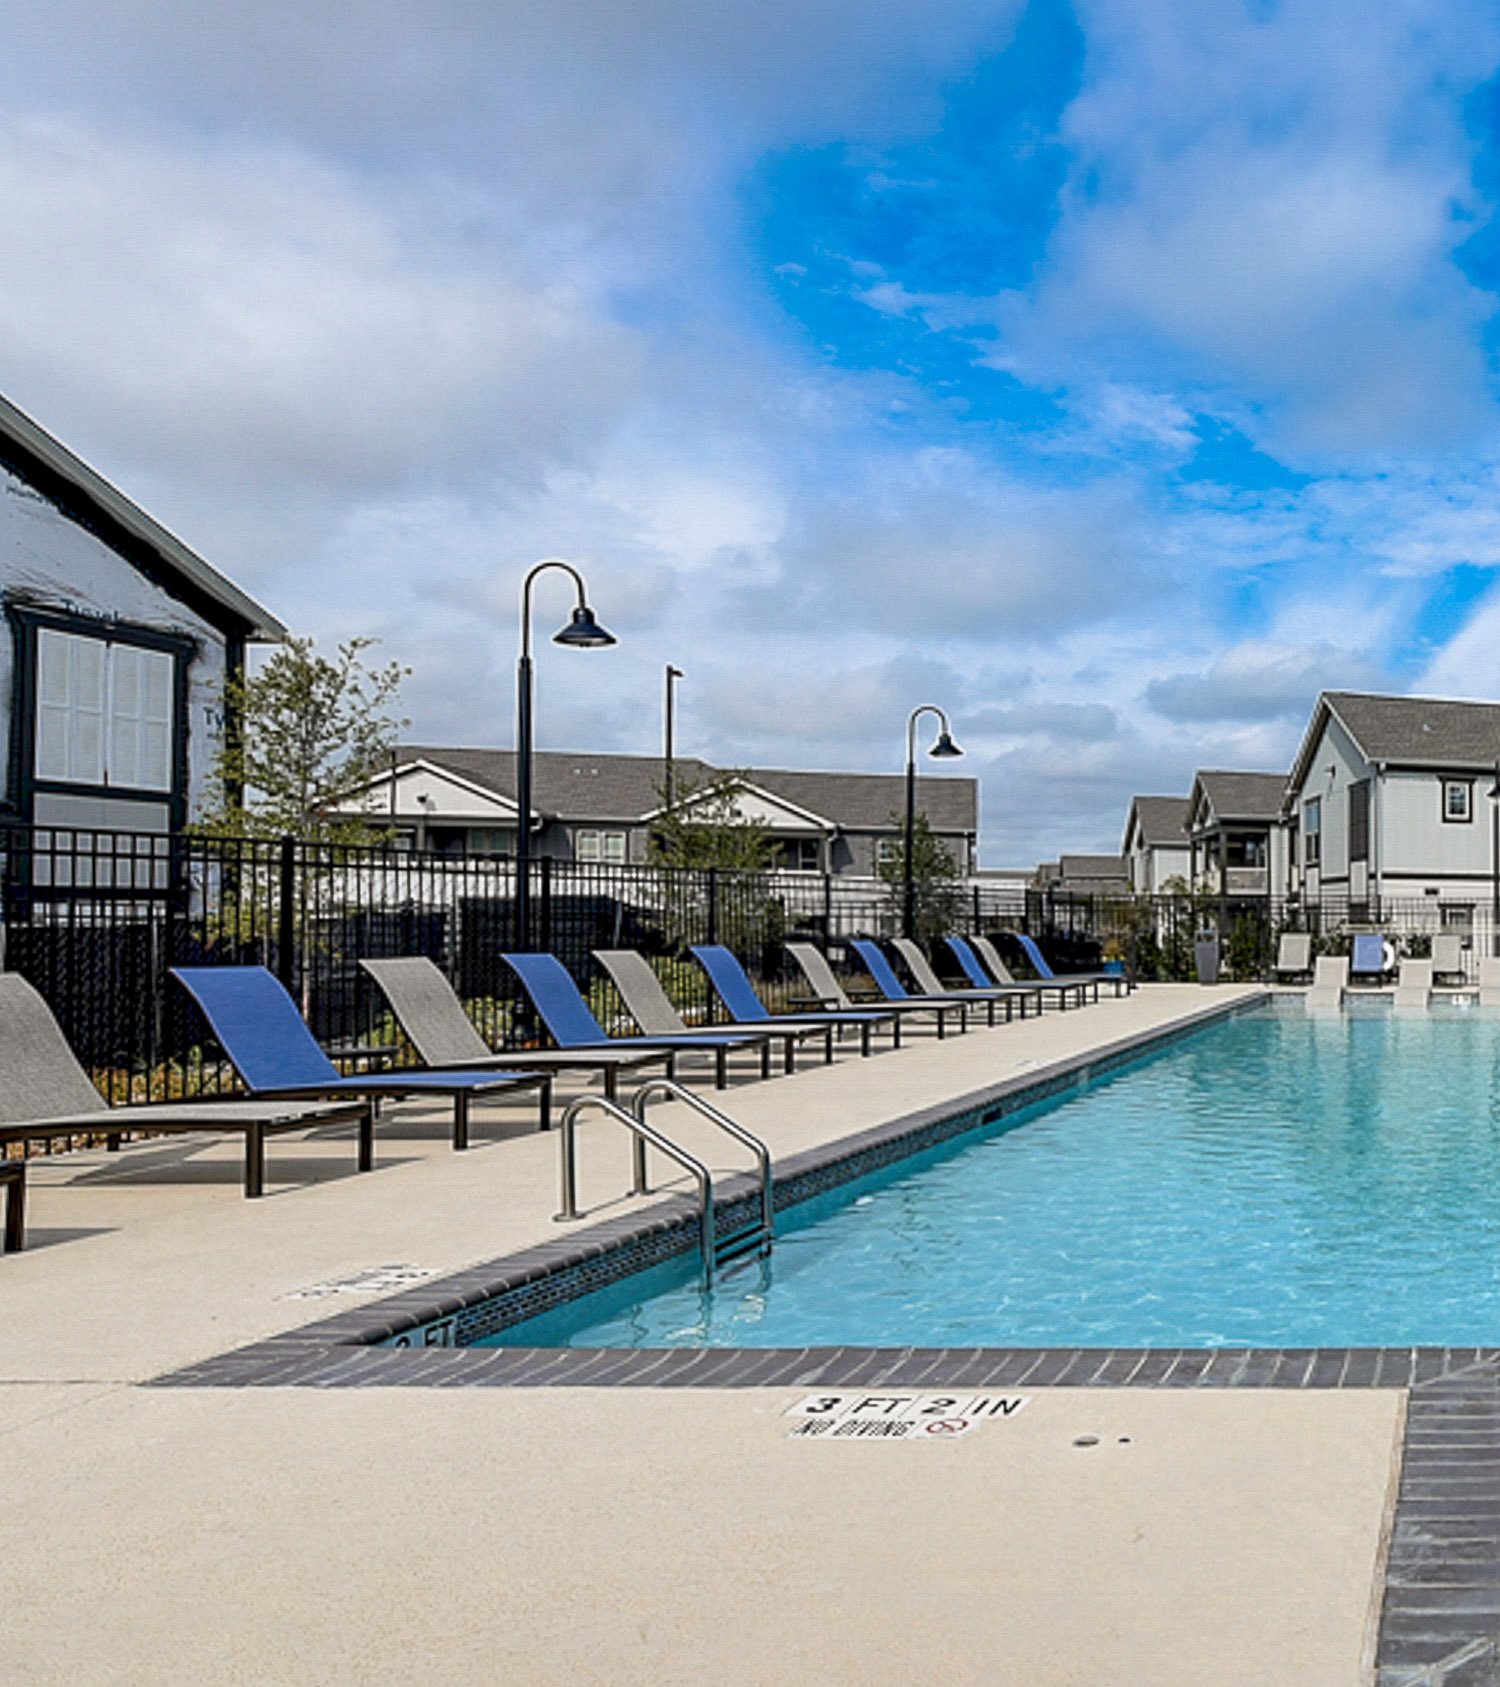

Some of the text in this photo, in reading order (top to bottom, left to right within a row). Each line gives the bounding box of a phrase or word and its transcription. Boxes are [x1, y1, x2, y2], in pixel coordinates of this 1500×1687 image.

[806, 1397, 1022, 1415] 3 FT 2 IN
[792, 1419, 916, 1437] NO DIVING
